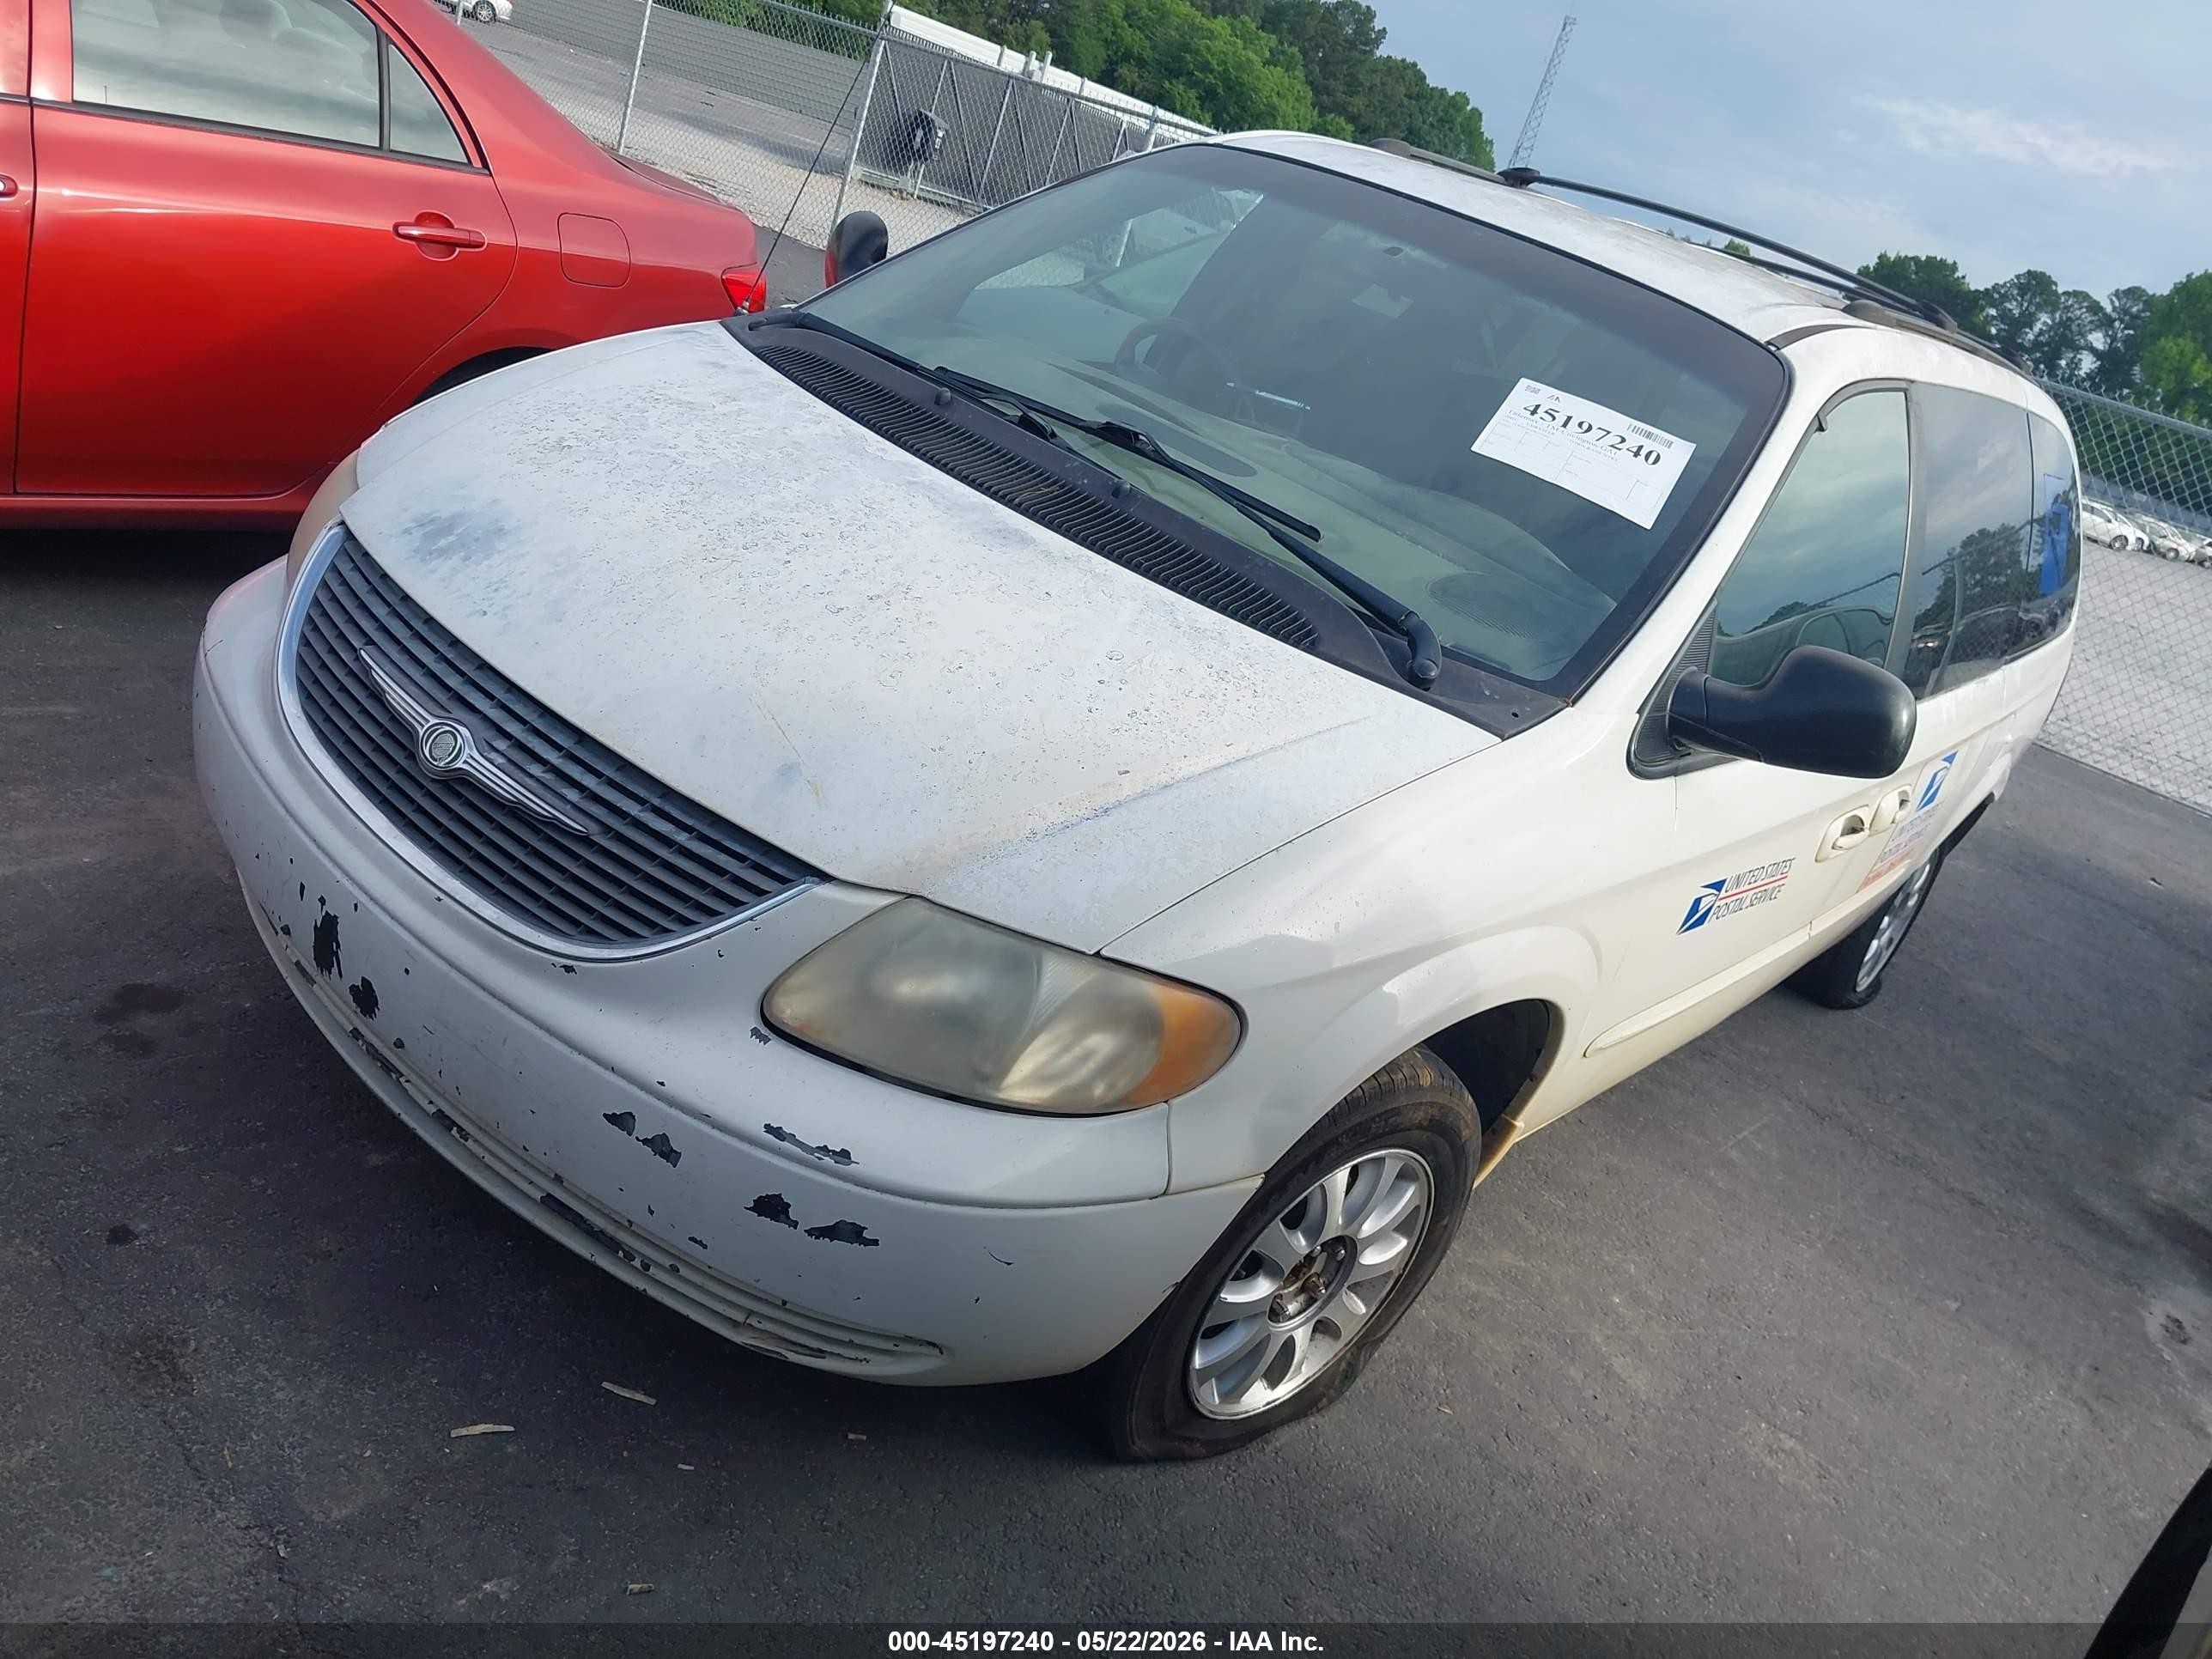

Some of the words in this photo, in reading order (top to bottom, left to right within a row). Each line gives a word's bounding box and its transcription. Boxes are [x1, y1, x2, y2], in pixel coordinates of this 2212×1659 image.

[1522, 403, 1662, 466] 45197240
[1724, 865, 1765, 894] UNITED
[1760, 856, 1796, 882] STATES
[1708, 894, 1749, 923] POSTAL
[1744, 883, 1786, 910] SERVICE
